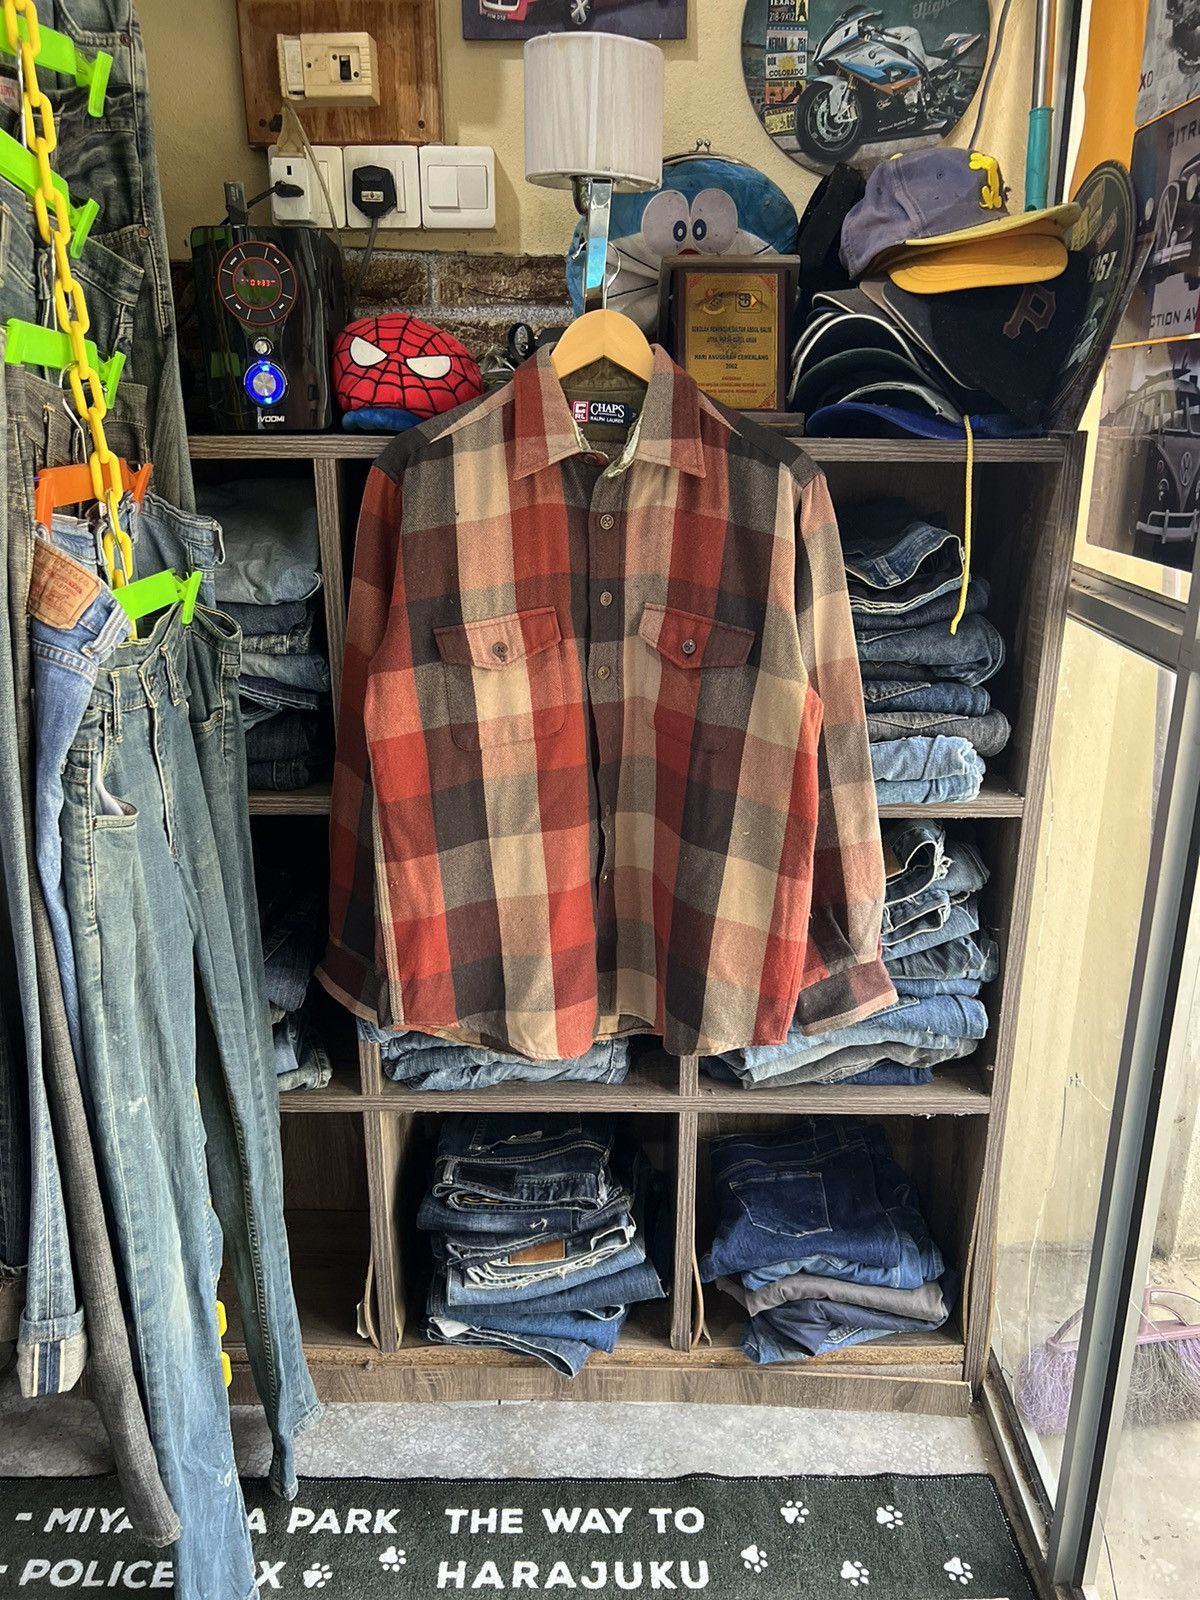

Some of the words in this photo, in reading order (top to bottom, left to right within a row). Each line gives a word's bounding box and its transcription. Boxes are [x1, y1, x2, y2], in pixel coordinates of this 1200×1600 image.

[768, 68, 804, 77] COLORADO
[1167, 120, 1200, 149] CITR
[590, 402, 625, 418] CHAPS
[286, 1506, 401, 1534] PARK
[445, 1507, 524, 1534] THE
[541, 1507, 632, 1534] WAY
[648, 1506, 705, 1534] TO
[19, 1558, 174, 1589] POLICE
[436, 1560, 710, 1590] HARAJUKU
